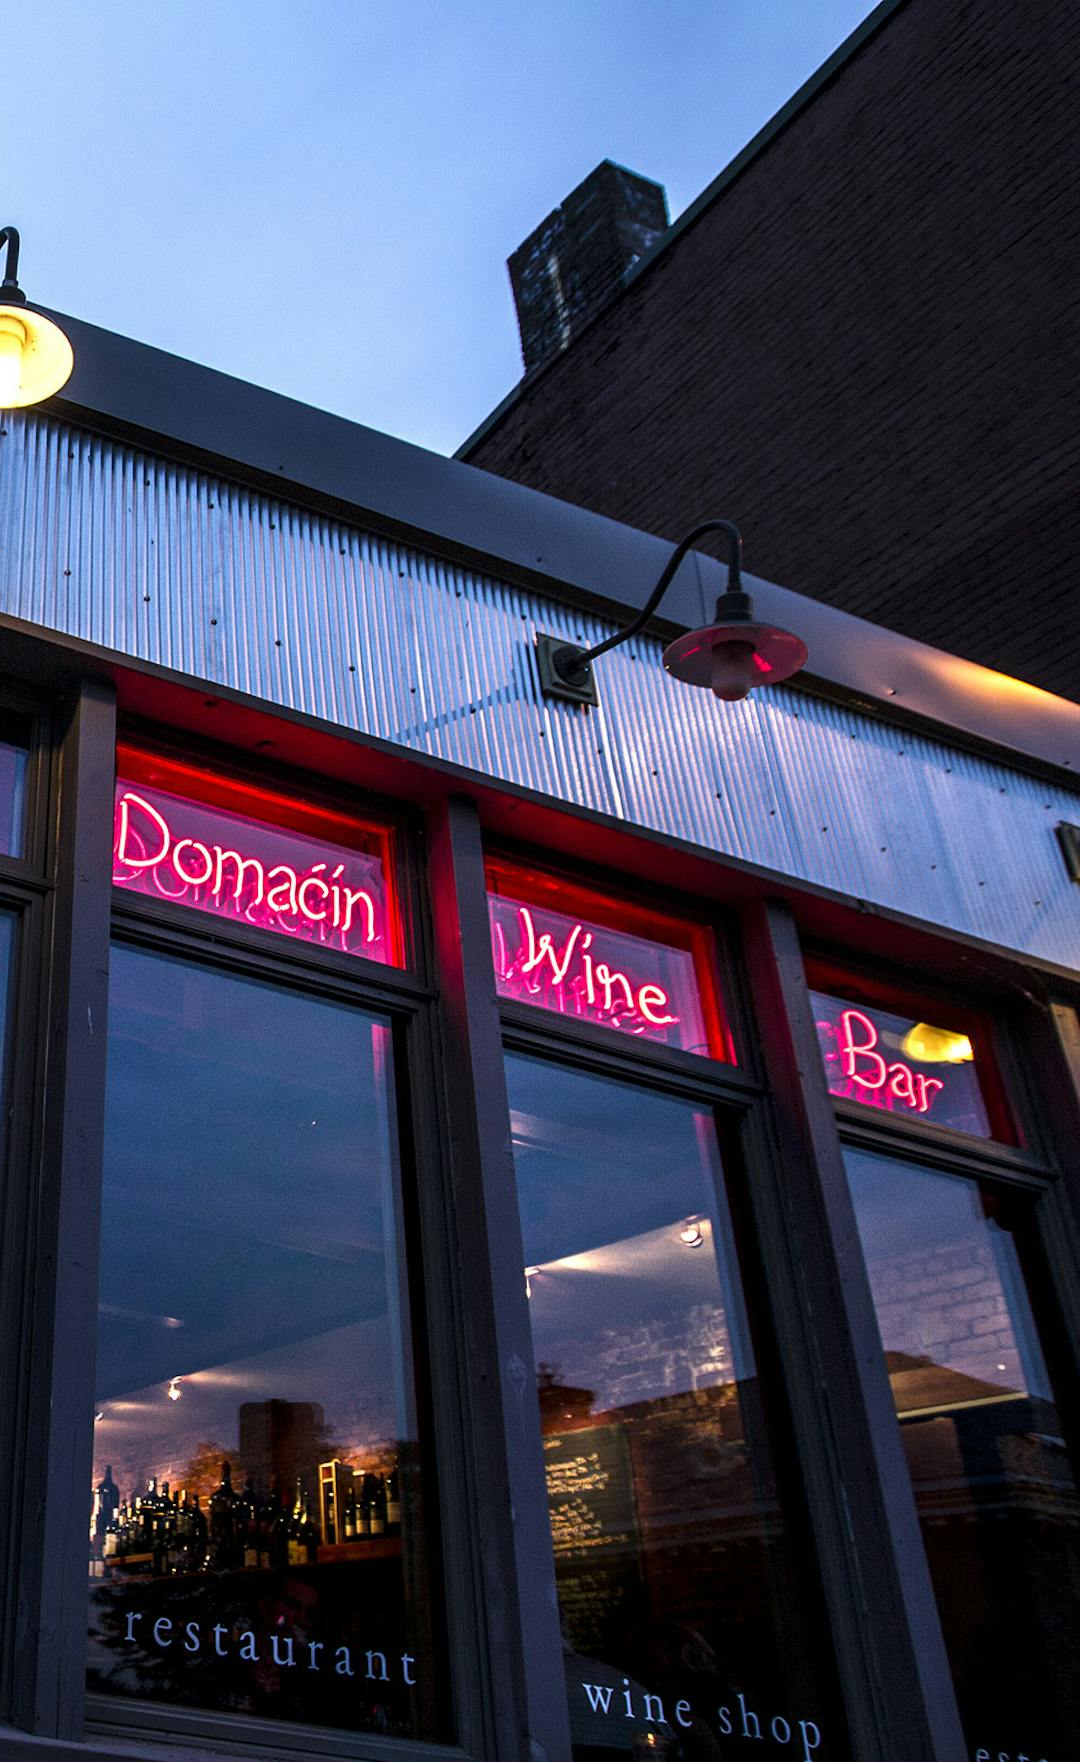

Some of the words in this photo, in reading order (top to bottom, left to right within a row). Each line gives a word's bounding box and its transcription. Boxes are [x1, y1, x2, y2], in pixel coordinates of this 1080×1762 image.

[519, 907, 675, 1024] Wine
[842, 1010, 944, 1112] Bar
[124, 1610, 416, 1685] restaurant
[581, 1678, 693, 1728] wine
[719, 1693, 821, 1762] shop
